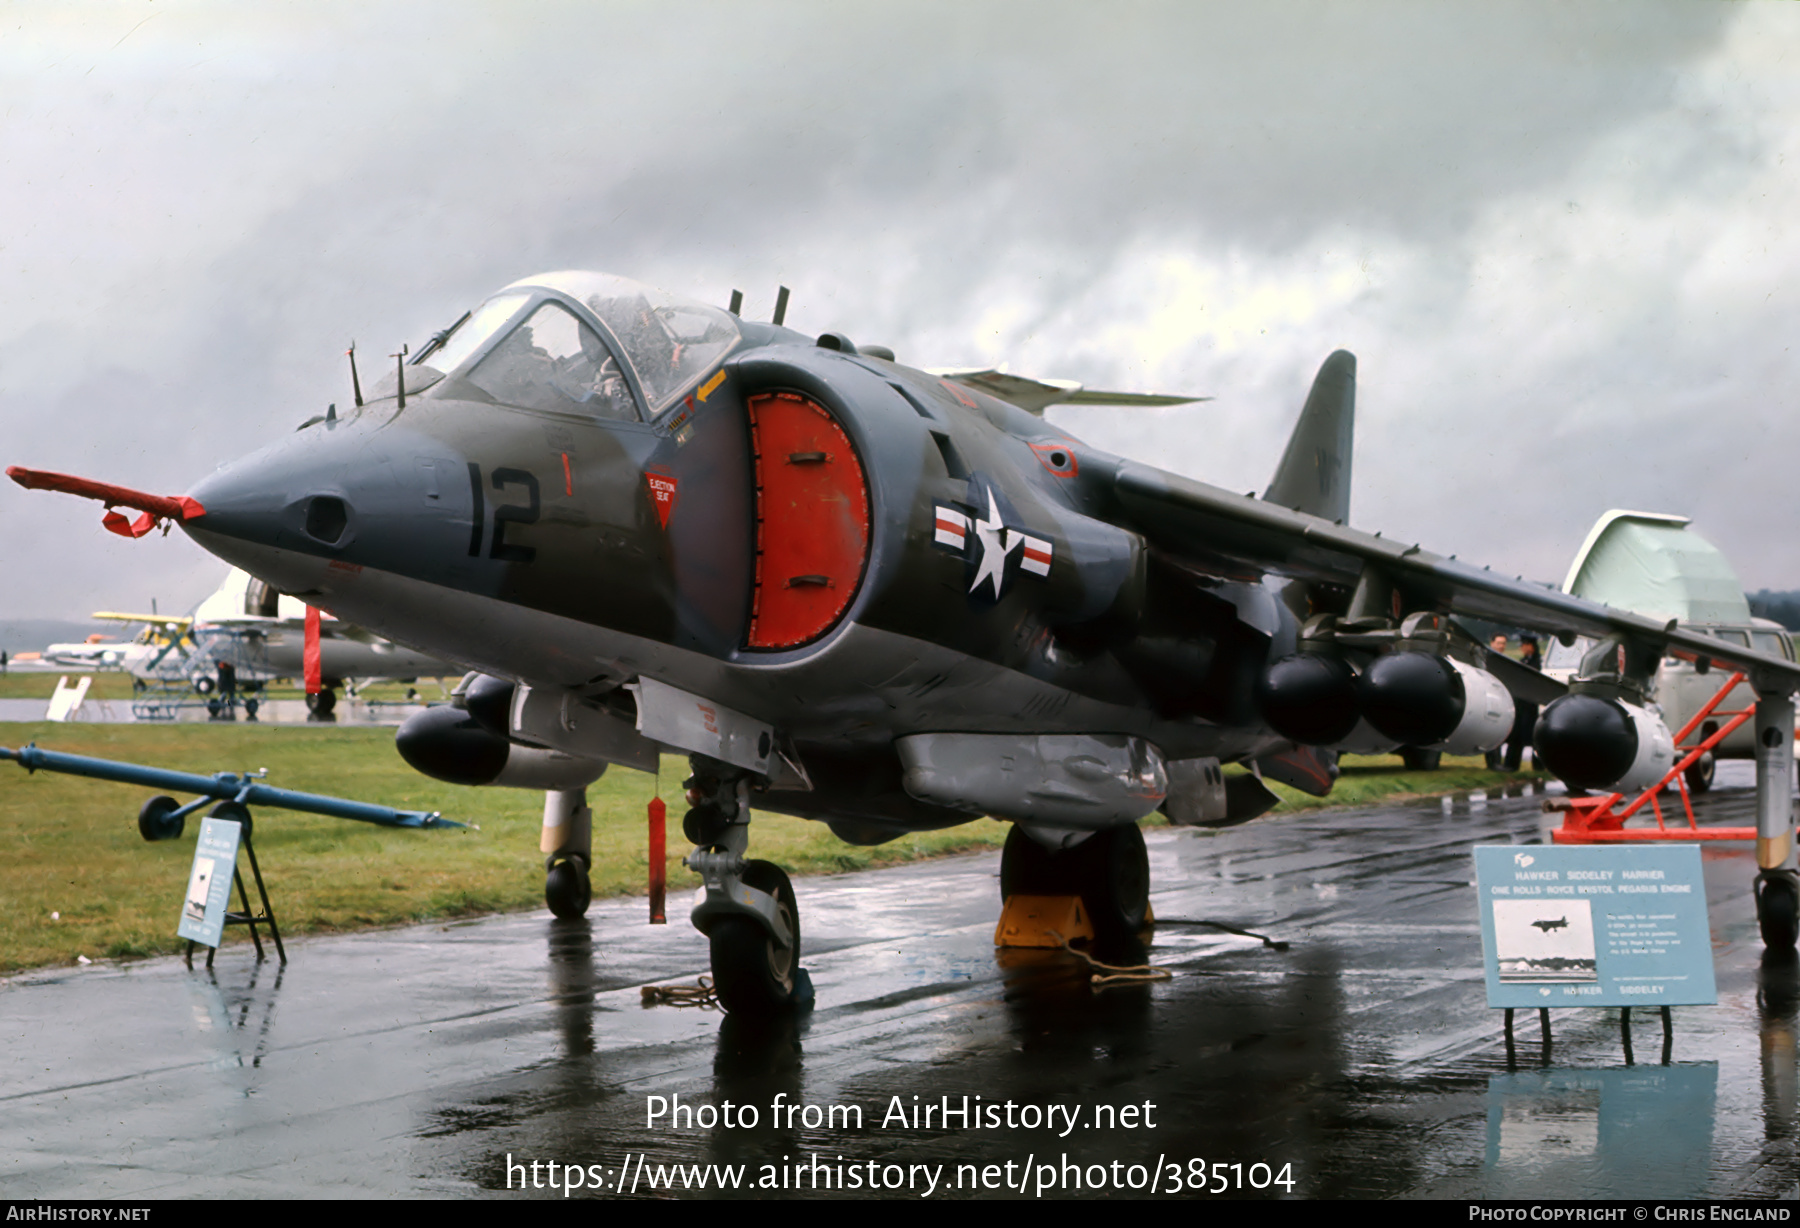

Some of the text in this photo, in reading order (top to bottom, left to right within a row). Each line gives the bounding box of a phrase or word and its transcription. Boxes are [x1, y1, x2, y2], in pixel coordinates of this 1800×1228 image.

[649, 478, 676, 493] EJECTION
[655, 490, 670, 502] SEAT
[467, 462, 541, 562] 12
[1515, 870, 1665, 881] HAWKER SIDDELEY HARRIER
[1491, 885, 1510, 895] ONE
[1577, 885, 1614, 894] BRISTOL
[1618, 884, 1658, 894] PEGASUS
[1661, 884, 1692, 894] ENGINE
[1563, 985, 1665, 996] HAWKER SIDDELEY
